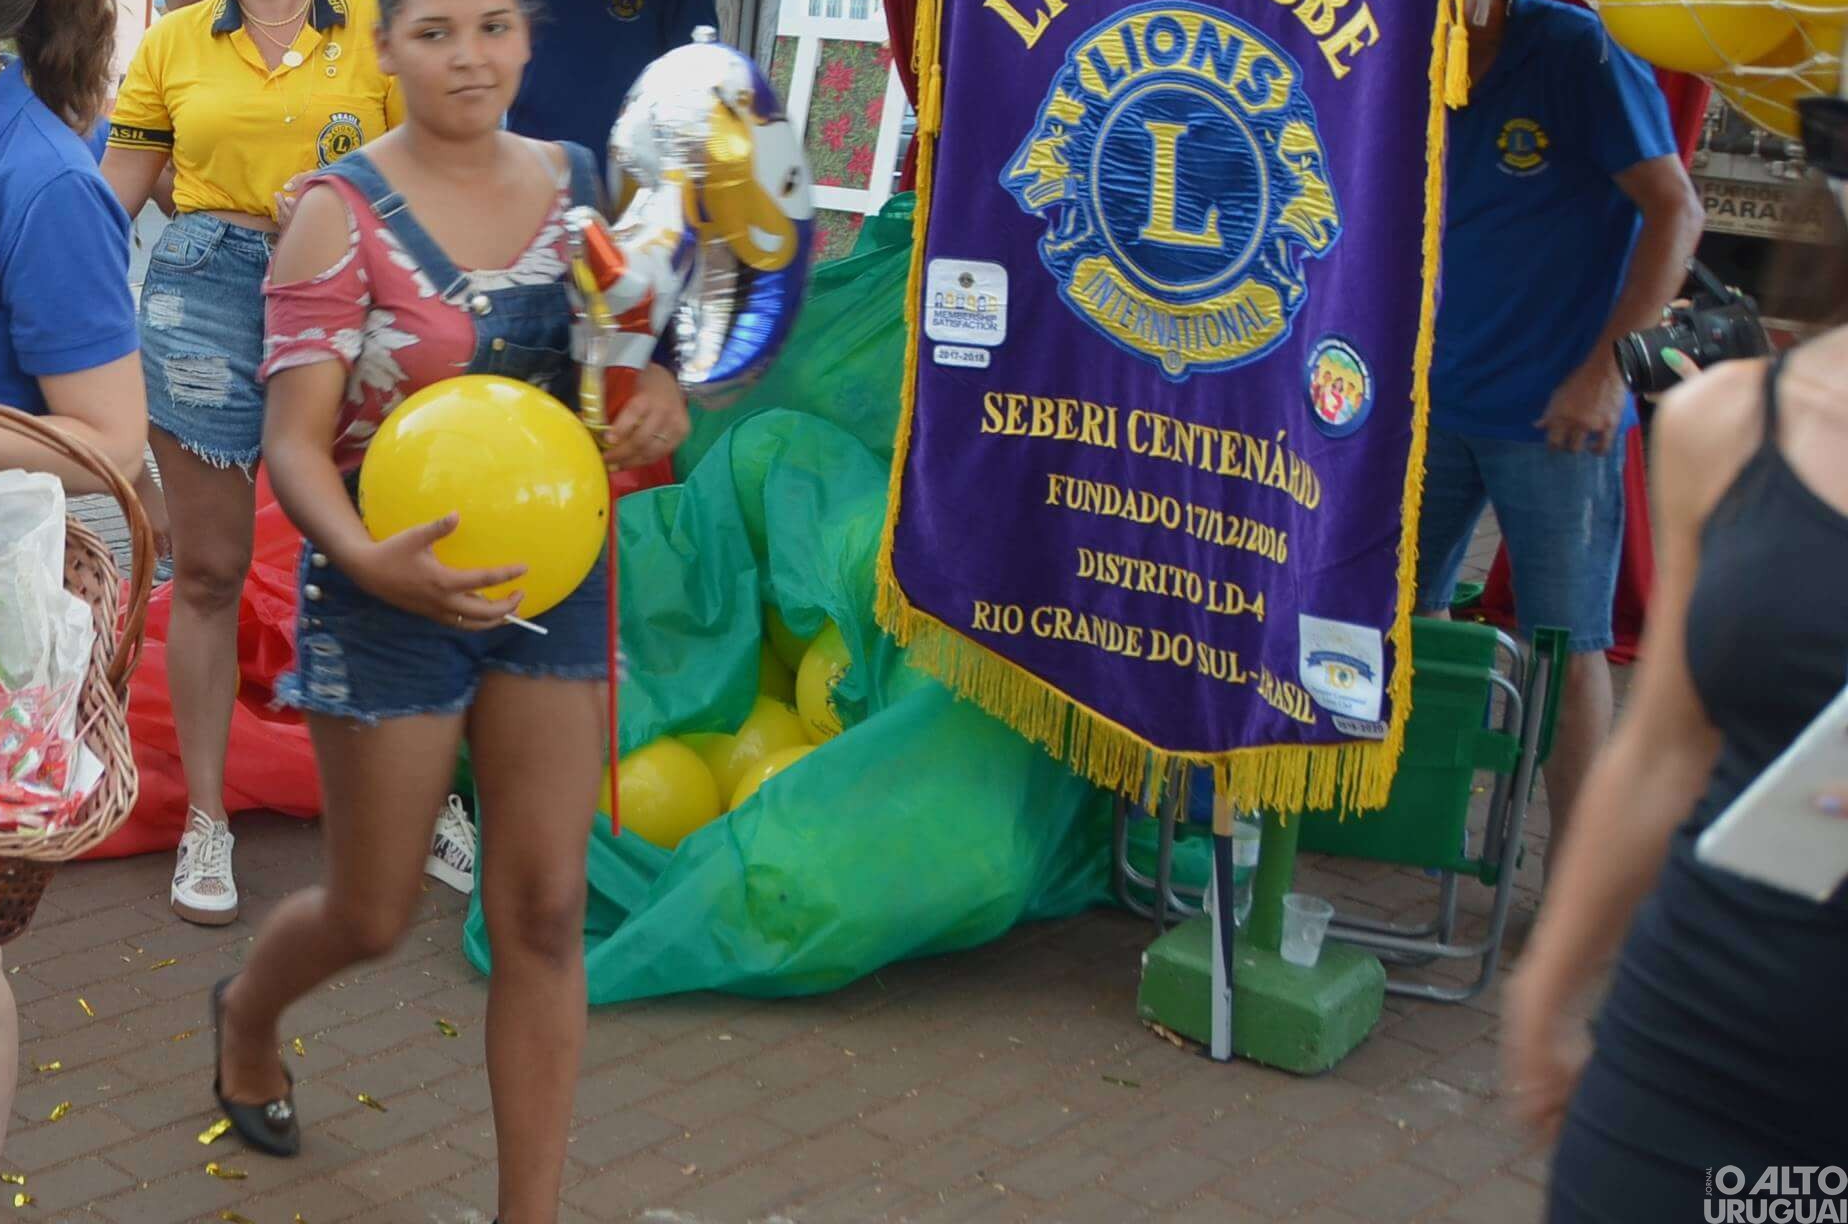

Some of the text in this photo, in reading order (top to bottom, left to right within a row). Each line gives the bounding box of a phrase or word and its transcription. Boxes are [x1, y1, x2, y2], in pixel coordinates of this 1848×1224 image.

[1087, 15, 1287, 106] LIONS
[110, 126, 148, 142] ASIL
[335, 136, 347, 152] L
[1137, 120, 1223, 248] L
[932, 318, 998, 331] SATISFACTION
[933, 310, 998, 323] MEMBERSHIP
[1080, 268, 1279, 352] INTERNATIONAL
[980, 392, 1322, 510] SEBERI CENTENÁRIO
[1045, 473, 1289, 565] FUNDADO 17/12/2016
[1076, 547, 1265, 623] DISTRITO LD-4
[970, 599, 1024, 635] RIO
[1031, 606, 1143, 659] GRANDE
[1146, 630, 1194, 665] DO
[1196, 640, 1247, 686] SUL
